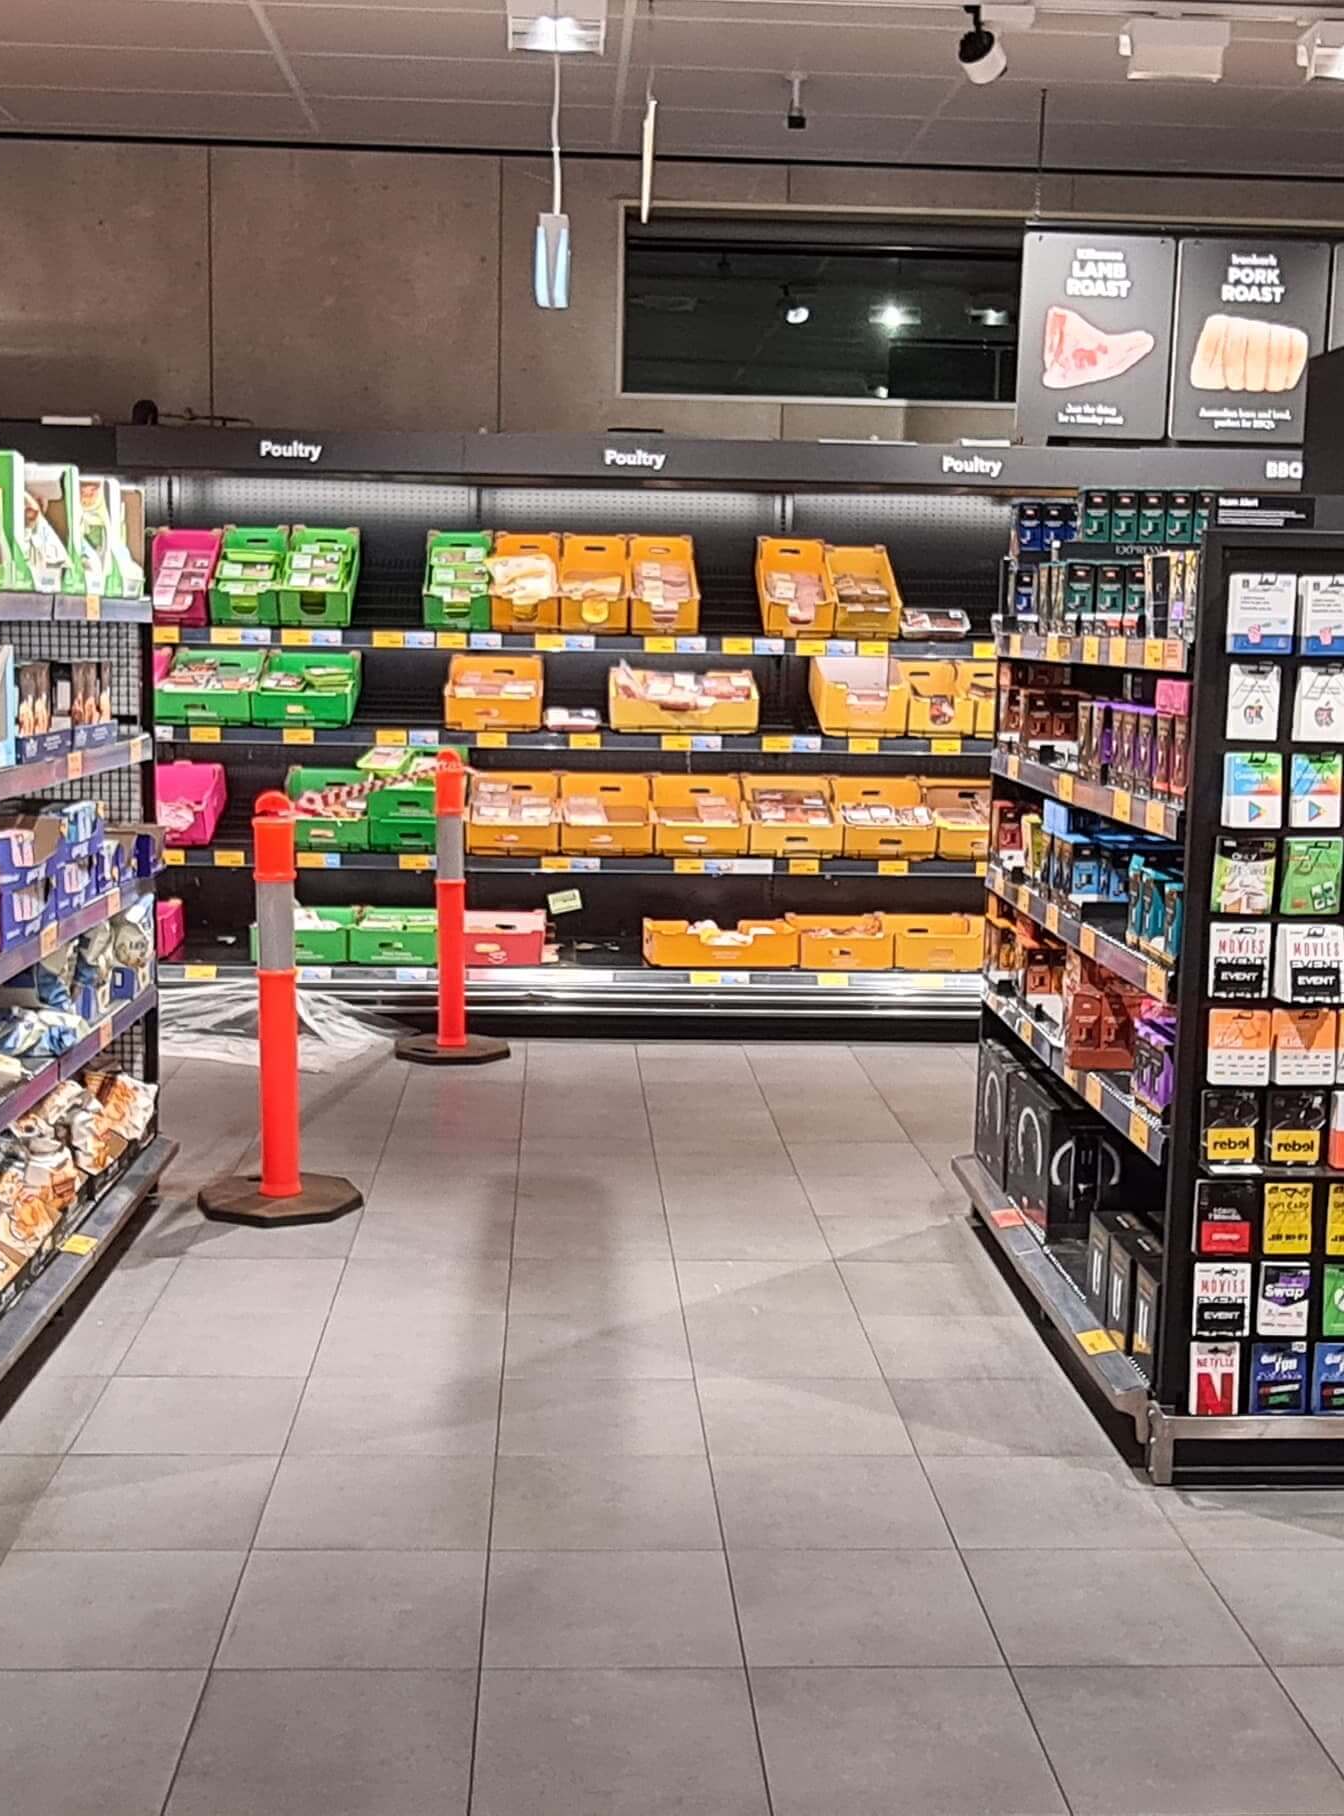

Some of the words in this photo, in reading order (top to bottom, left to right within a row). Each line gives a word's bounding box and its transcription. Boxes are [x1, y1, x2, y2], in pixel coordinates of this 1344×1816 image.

[1071, 260, 1127, 279] LAMB
[1228, 266, 1280, 284] PORK
[1066, 277, 1132, 298] ROAST
[1221, 284, 1285, 303] ROAST
[259, 440, 323, 464] Poultry
[604, 449, 667, 471] Poultry
[942, 455, 1003, 478] Poultry
[1265, 460, 1303, 481] BBQ
[1218, 938, 1265, 955] MOVIES
[1293, 941, 1341, 957] MOVIES
[1220, 971, 1259, 982] EVENT
[1297, 975, 1336, 986] EVENT
[1212, 1136, 1250, 1151] rebel
[1277, 1139, 1315, 1153] rebel
[1200, 1278, 1246, 1294] MOVIES
[1264, 1284, 1306, 1300] Swap
[1203, 1310, 1241, 1320] EVENT
[1196, 1356, 1235, 1368] NETFLIX
